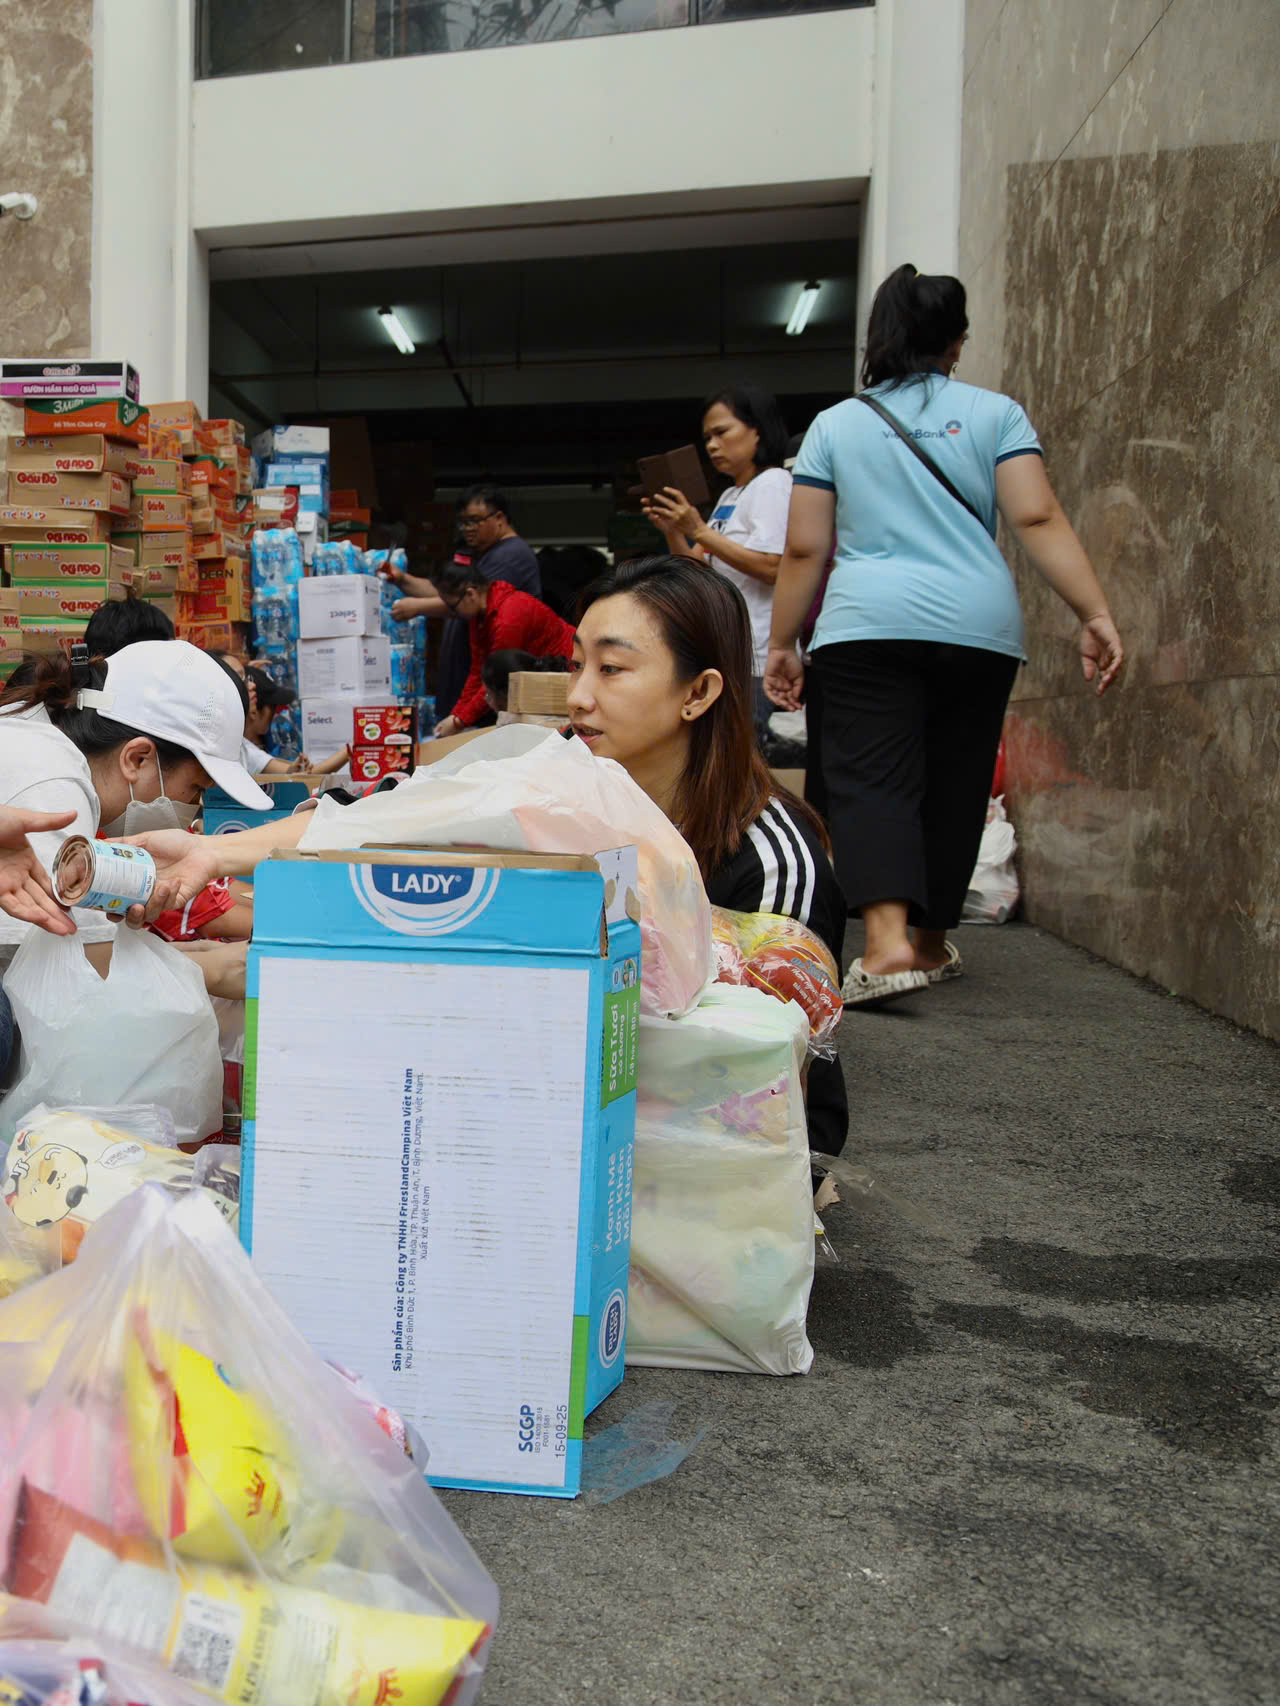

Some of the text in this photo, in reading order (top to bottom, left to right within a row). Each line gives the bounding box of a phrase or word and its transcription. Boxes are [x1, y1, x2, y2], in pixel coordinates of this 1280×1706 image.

[330, 610, 357, 618] Select
[308, 717, 332, 725] Select
[392, 872, 455, 894] LADY
[609, 1004, 619, 1092] Sữa Tươi
[391, 1068, 414, 1372] Sản phẩm của: Công ty TNHH FrieslandCampina Việt Nam
[606, 1308, 617, 1351] DUTCH
[612, 1311, 620, 1342] LADY
[518, 1404, 535, 1453] SCGP
[554, 1404, 568, 1459] 15-09-25
